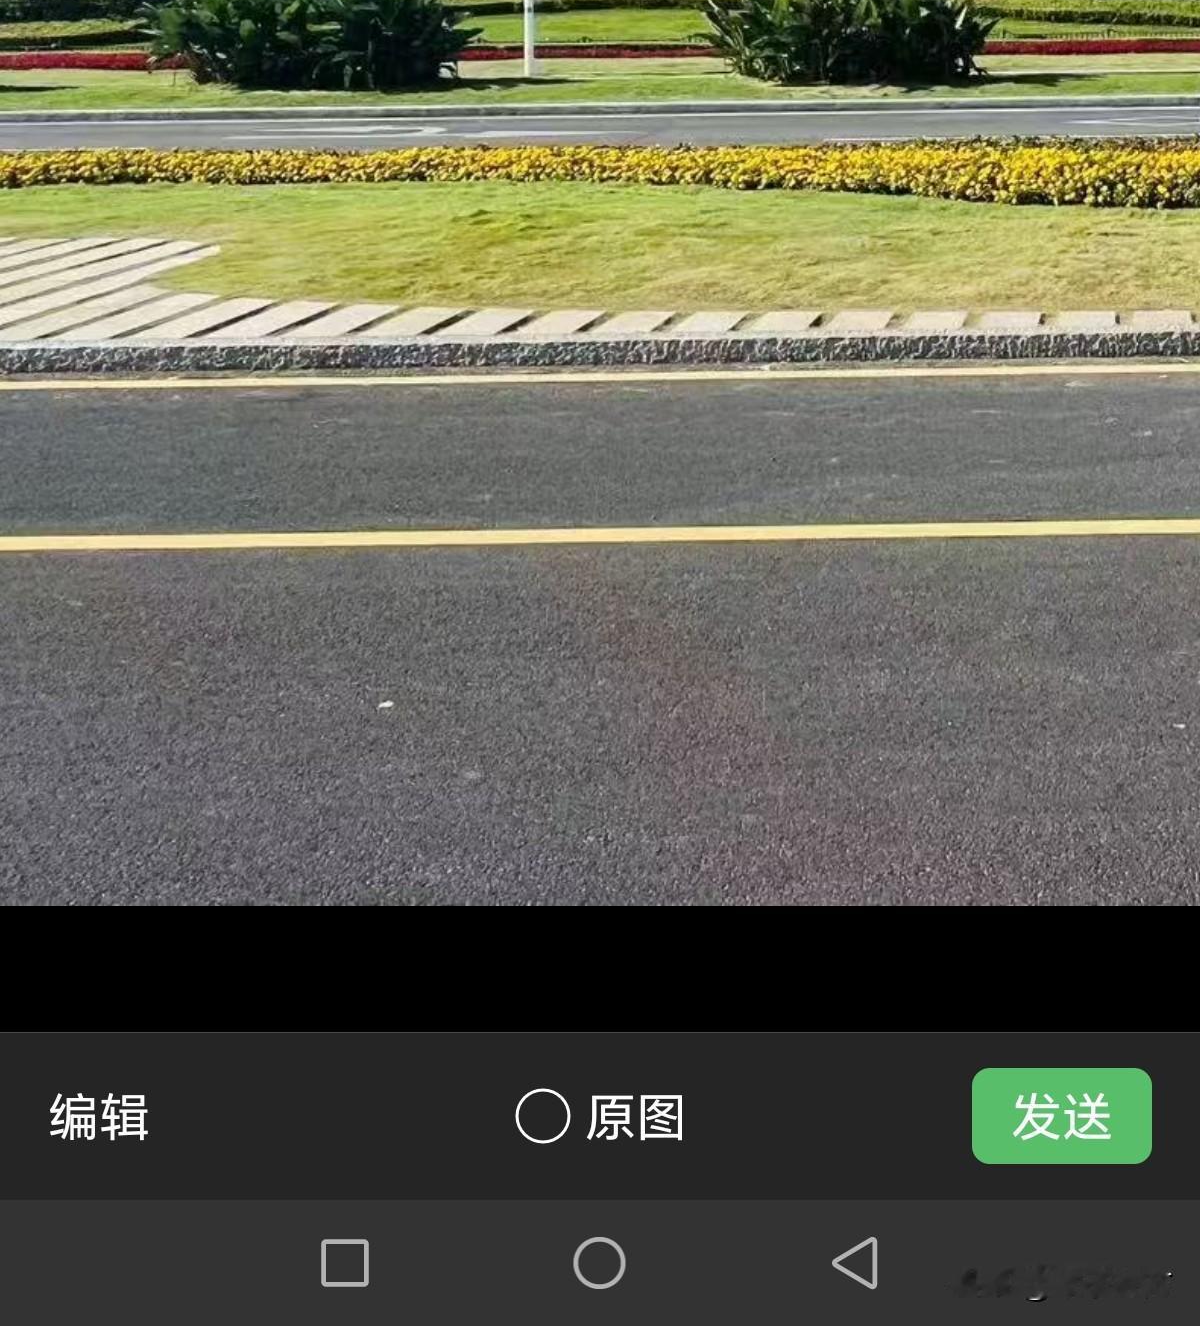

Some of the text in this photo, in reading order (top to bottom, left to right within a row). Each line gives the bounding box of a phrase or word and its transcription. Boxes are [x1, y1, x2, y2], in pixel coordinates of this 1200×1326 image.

[49, 1092, 149, 1141] 编辑
[586, 1094, 684, 1141] 原图
[1012, 1092, 1112, 1141] 发送
